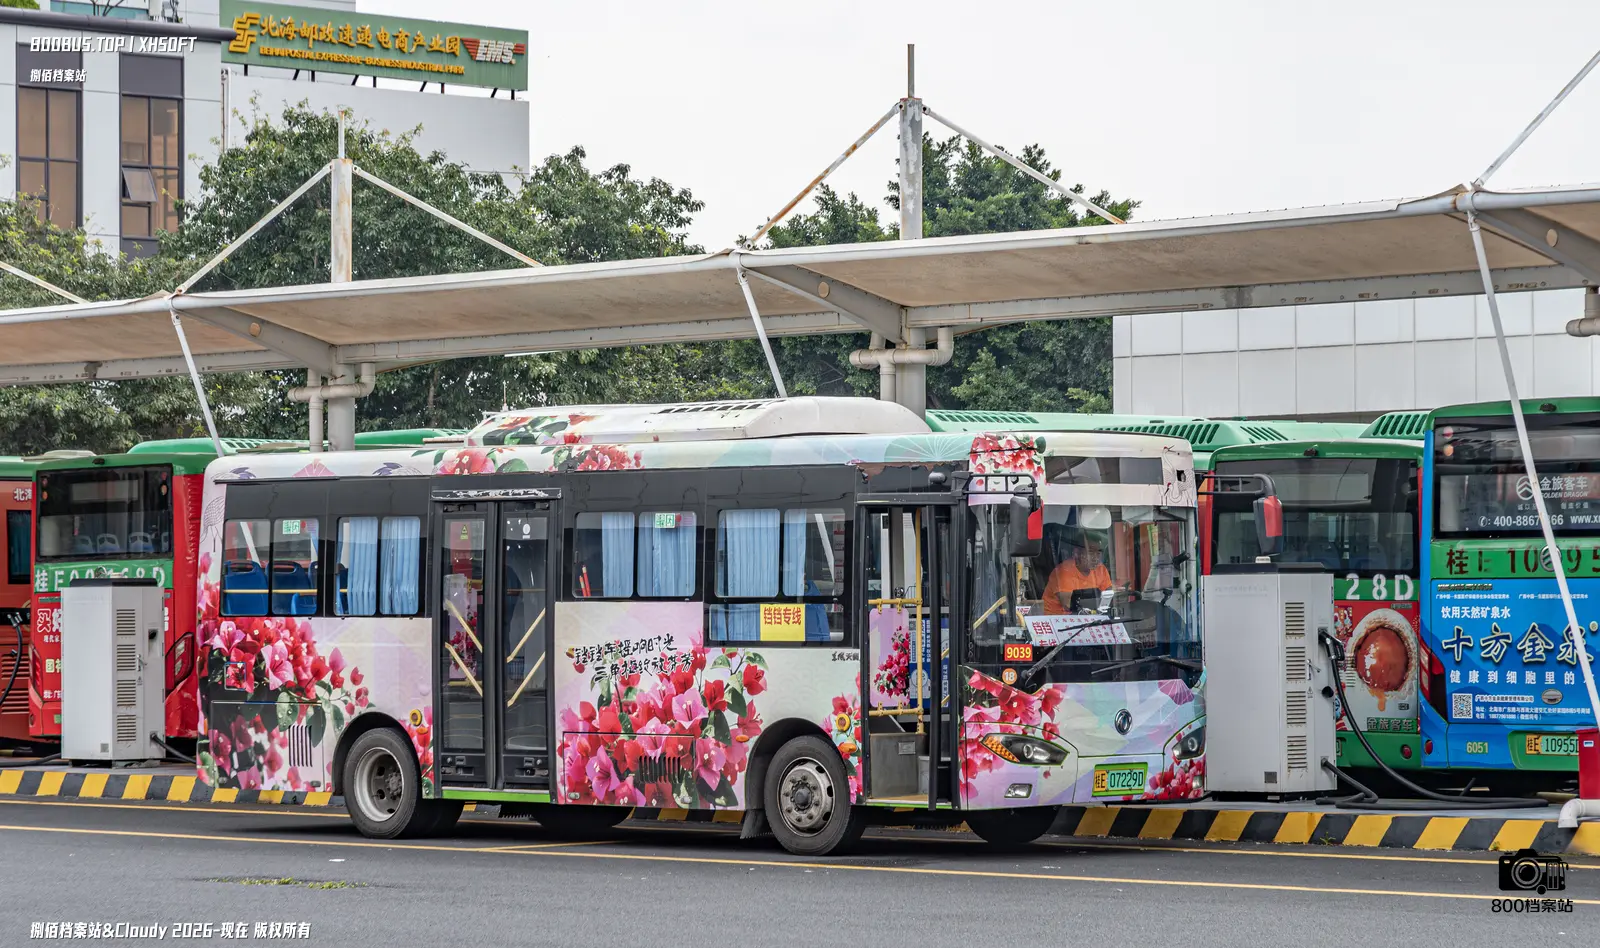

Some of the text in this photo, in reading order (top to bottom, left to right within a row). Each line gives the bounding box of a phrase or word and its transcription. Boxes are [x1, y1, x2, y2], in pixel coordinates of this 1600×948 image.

[261, 14, 461, 57] 北海邮政速递电商产业园
[1540, 476, 1588, 491] 金旅客车
[1493, 514, 1564, 527] 400-886766
[763, 606, 802, 625] 铛铛专线
[1441, 606, 1511, 619] 饮用天然矿泉水
[1006, 647, 1031, 659] 9039
[1004, 671, 1015, 681] 18
[1450, 669, 1595, 685] 健康到细胞里的
[1367, 717, 1413, 731] 金旅客车
[1466, 742, 1489, 754] 6051
